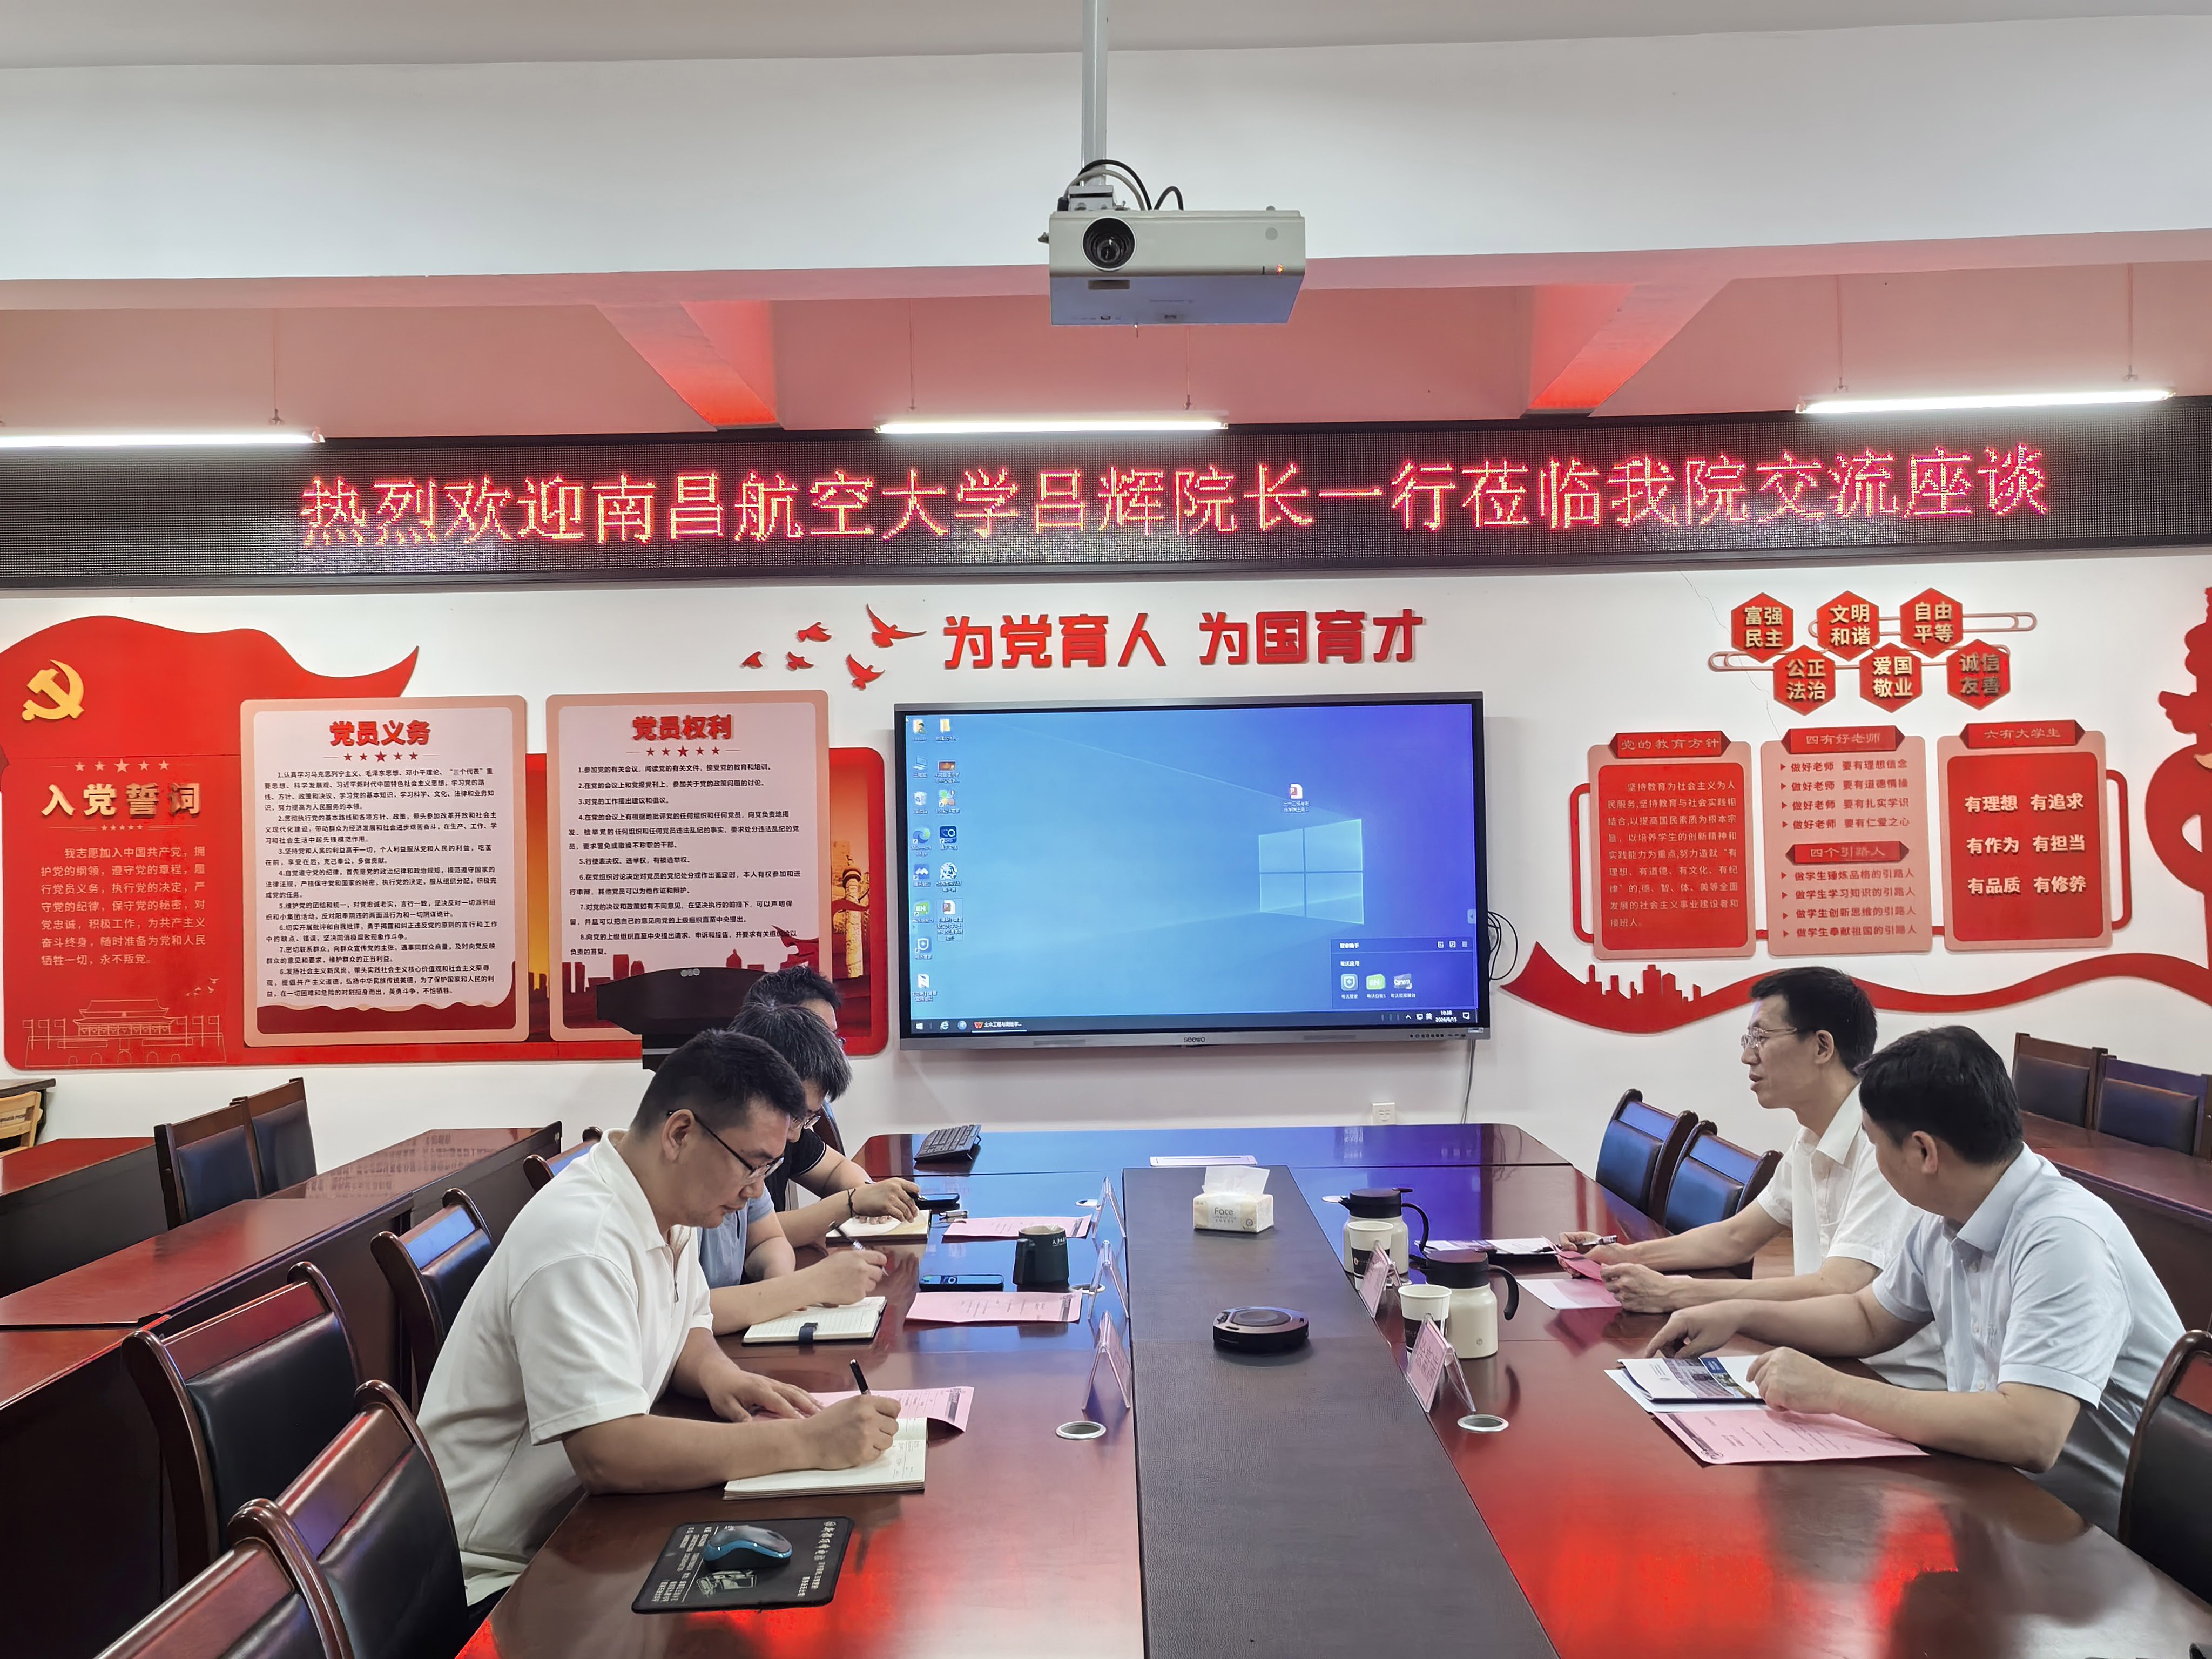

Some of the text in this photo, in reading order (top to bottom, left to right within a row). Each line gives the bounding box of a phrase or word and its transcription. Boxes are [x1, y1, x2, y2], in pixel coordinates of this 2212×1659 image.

[300, 443, 2047, 545] 热烈欢迎南昌航空大学吕辉院长一行莅临我院交流座谈
[1744, 605, 1783, 626] 富强
[1830, 604, 1870, 623] 文明
[1914, 602, 1953, 621] 自由
[945, 610, 1424, 668] 为党育人 为国育才
[1745, 629, 1783, 648] 民主
[1831, 626, 1871, 646] 和谐
[1914, 623, 1954, 643] 平等
[1786, 658, 1826, 678] 公正
[1873, 656, 1913, 676] 爱国
[1960, 652, 2000, 673] 诚信
[1787, 681, 1826, 700] 法治
[1873, 678, 1913, 698] 敬业
[1960, 676, 2000, 696] 友善
[330, 720, 431, 747] 党员义务
[632, 715, 732, 741] 党员权利
[1984, 728, 2061, 739] 六有大学生
[1622, 738, 1721, 750] 党的教育方针
[1806, 733, 1880, 745] 四有好老师
[1791, 759, 1907, 773] 做好老师 要有理想信念
[1627, 781, 1736, 792] 坚持教育为社会主义为人
[1791, 779, 1908, 792] 做好老师 要有道德情操
[42, 783, 200, 816] 入党誓词
[1792, 798, 1909, 811] 做好老师 要有扎实学识
[1965, 793, 2084, 813] 有理想 有追求
[1793, 817, 1910, 830] 做好老师 要有仁爱之心
[1810, 846, 1885, 858] 四个引路人
[1967, 834, 2085, 854] 有作为 有担当
[1795, 868, 1914, 882] 做学生锤炼品格的引路人
[1796, 887, 1915, 900] 做学生学习知识的引路人
[1968, 875, 2087, 895] 有品质 有修养
[1610, 899, 1738, 911] 发展的社会主义事业建设者和
[1796, 906, 1916, 919] 做学生创新思维的引路人
[1797, 925, 1917, 938] 做学生奉献祖国的引路人
[1215, 1207, 1234, 1216] Face
